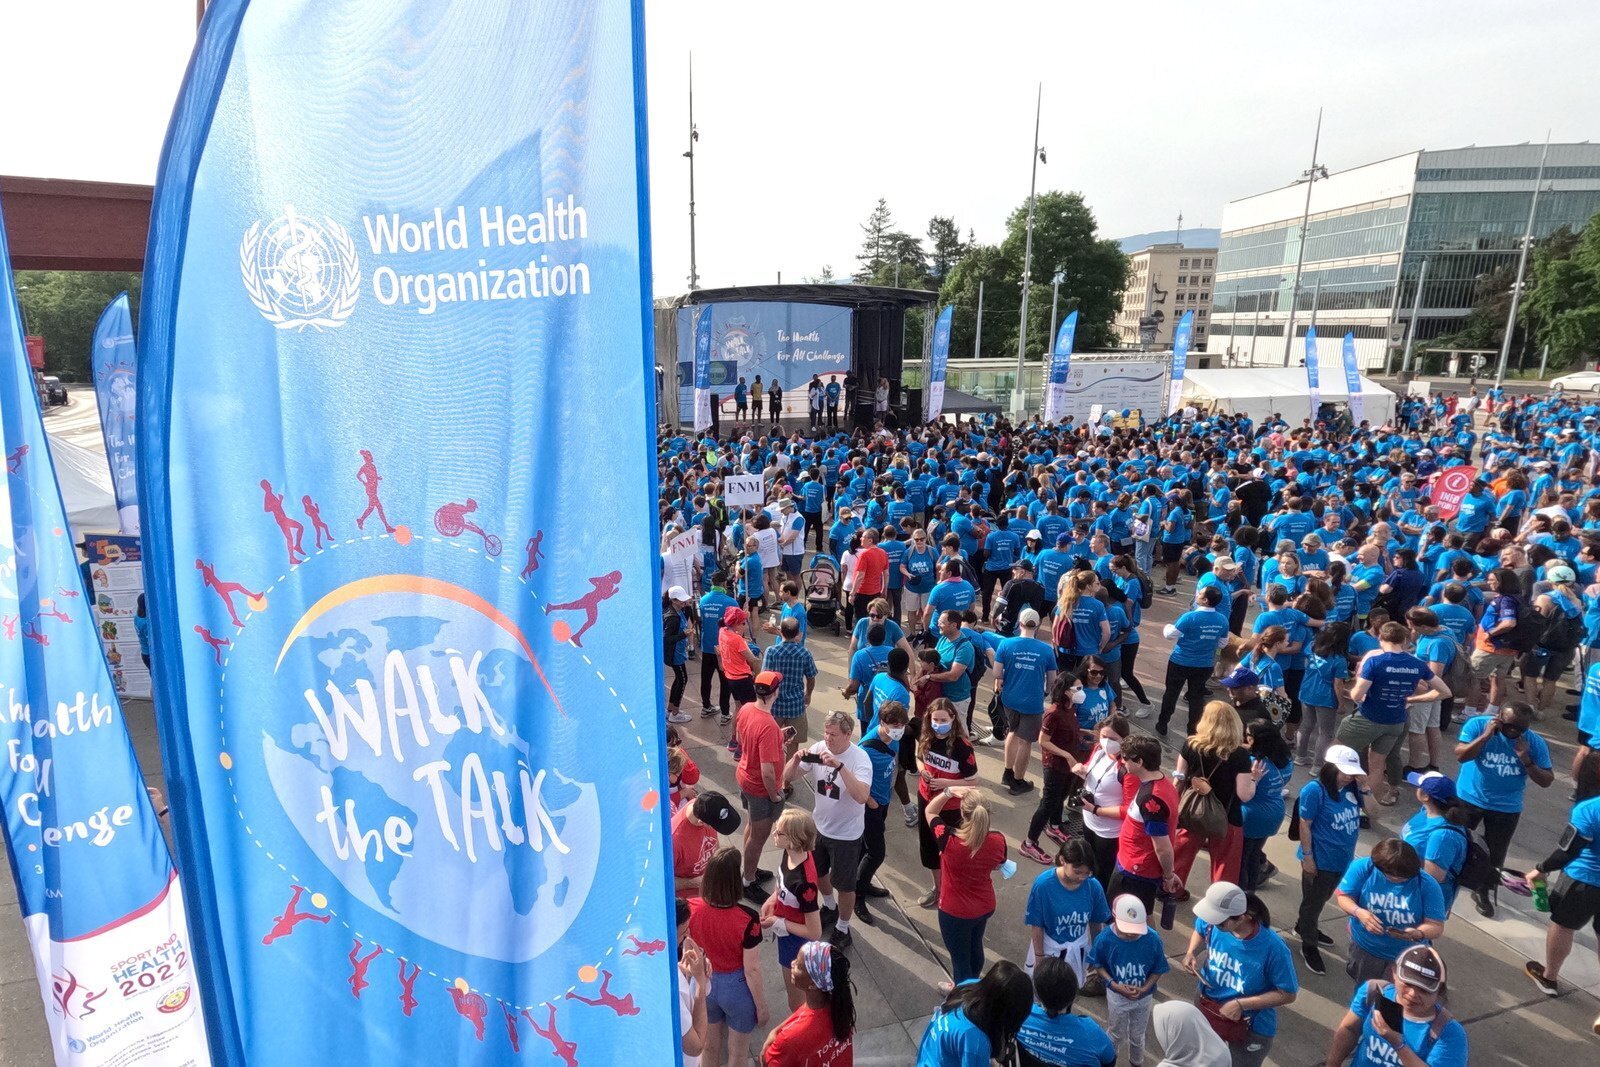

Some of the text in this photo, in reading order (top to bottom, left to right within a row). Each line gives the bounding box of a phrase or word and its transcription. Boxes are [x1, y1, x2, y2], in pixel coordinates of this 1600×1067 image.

[363, 194, 588, 254] World Health
[373, 254, 591, 315] Organization
[728, 481, 761, 494] FNM
[671, 535, 695, 554] FNM
[304, 649, 506, 763] WALK
[925, 753, 952, 770] ANADA
[1486, 751, 1519, 764] WALK
[1496, 764, 1521, 777] TALK
[315, 752, 571, 864] the TALK
[1369, 891, 1412, 911] WALK
[1057, 911, 1090, 926] WALK
[1383, 909, 1417, 926] TALK
[110, 933, 178, 973] SPORT AND
[112, 940, 183, 984] HEALTH
[1208, 946, 1243, 977] WALK
[119, 951, 188, 997] 2022
[1213, 966, 1245, 995] TALK
[86, 1026, 112, 1043] World
